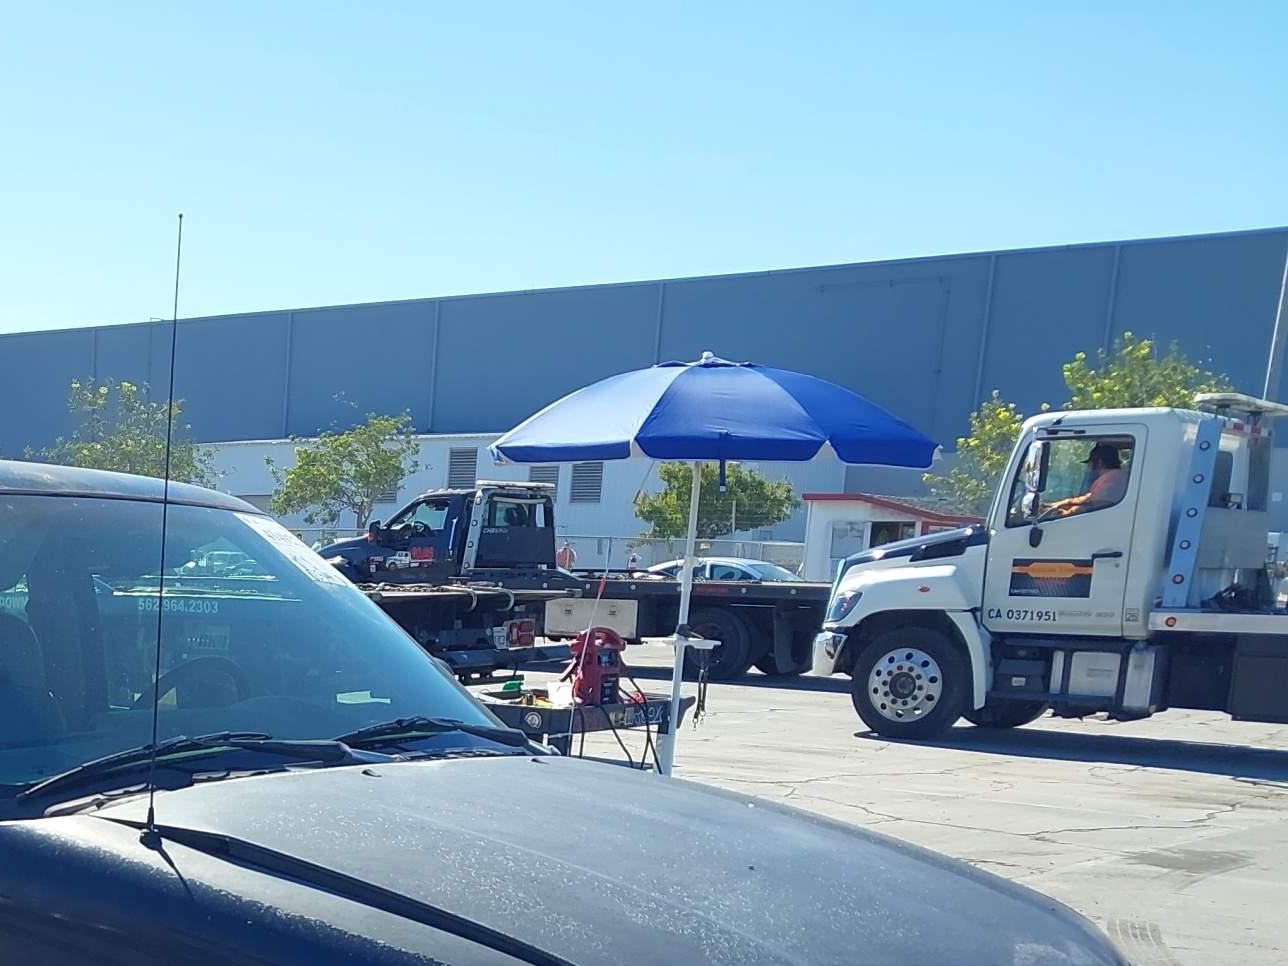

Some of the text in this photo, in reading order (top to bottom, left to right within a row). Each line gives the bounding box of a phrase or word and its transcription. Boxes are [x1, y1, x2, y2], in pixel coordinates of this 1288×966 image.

[138, 598, 219, 613] 562964.2303
[988, 608, 1002, 620] CA
[1006, 609, 1057, 621] 0371951
